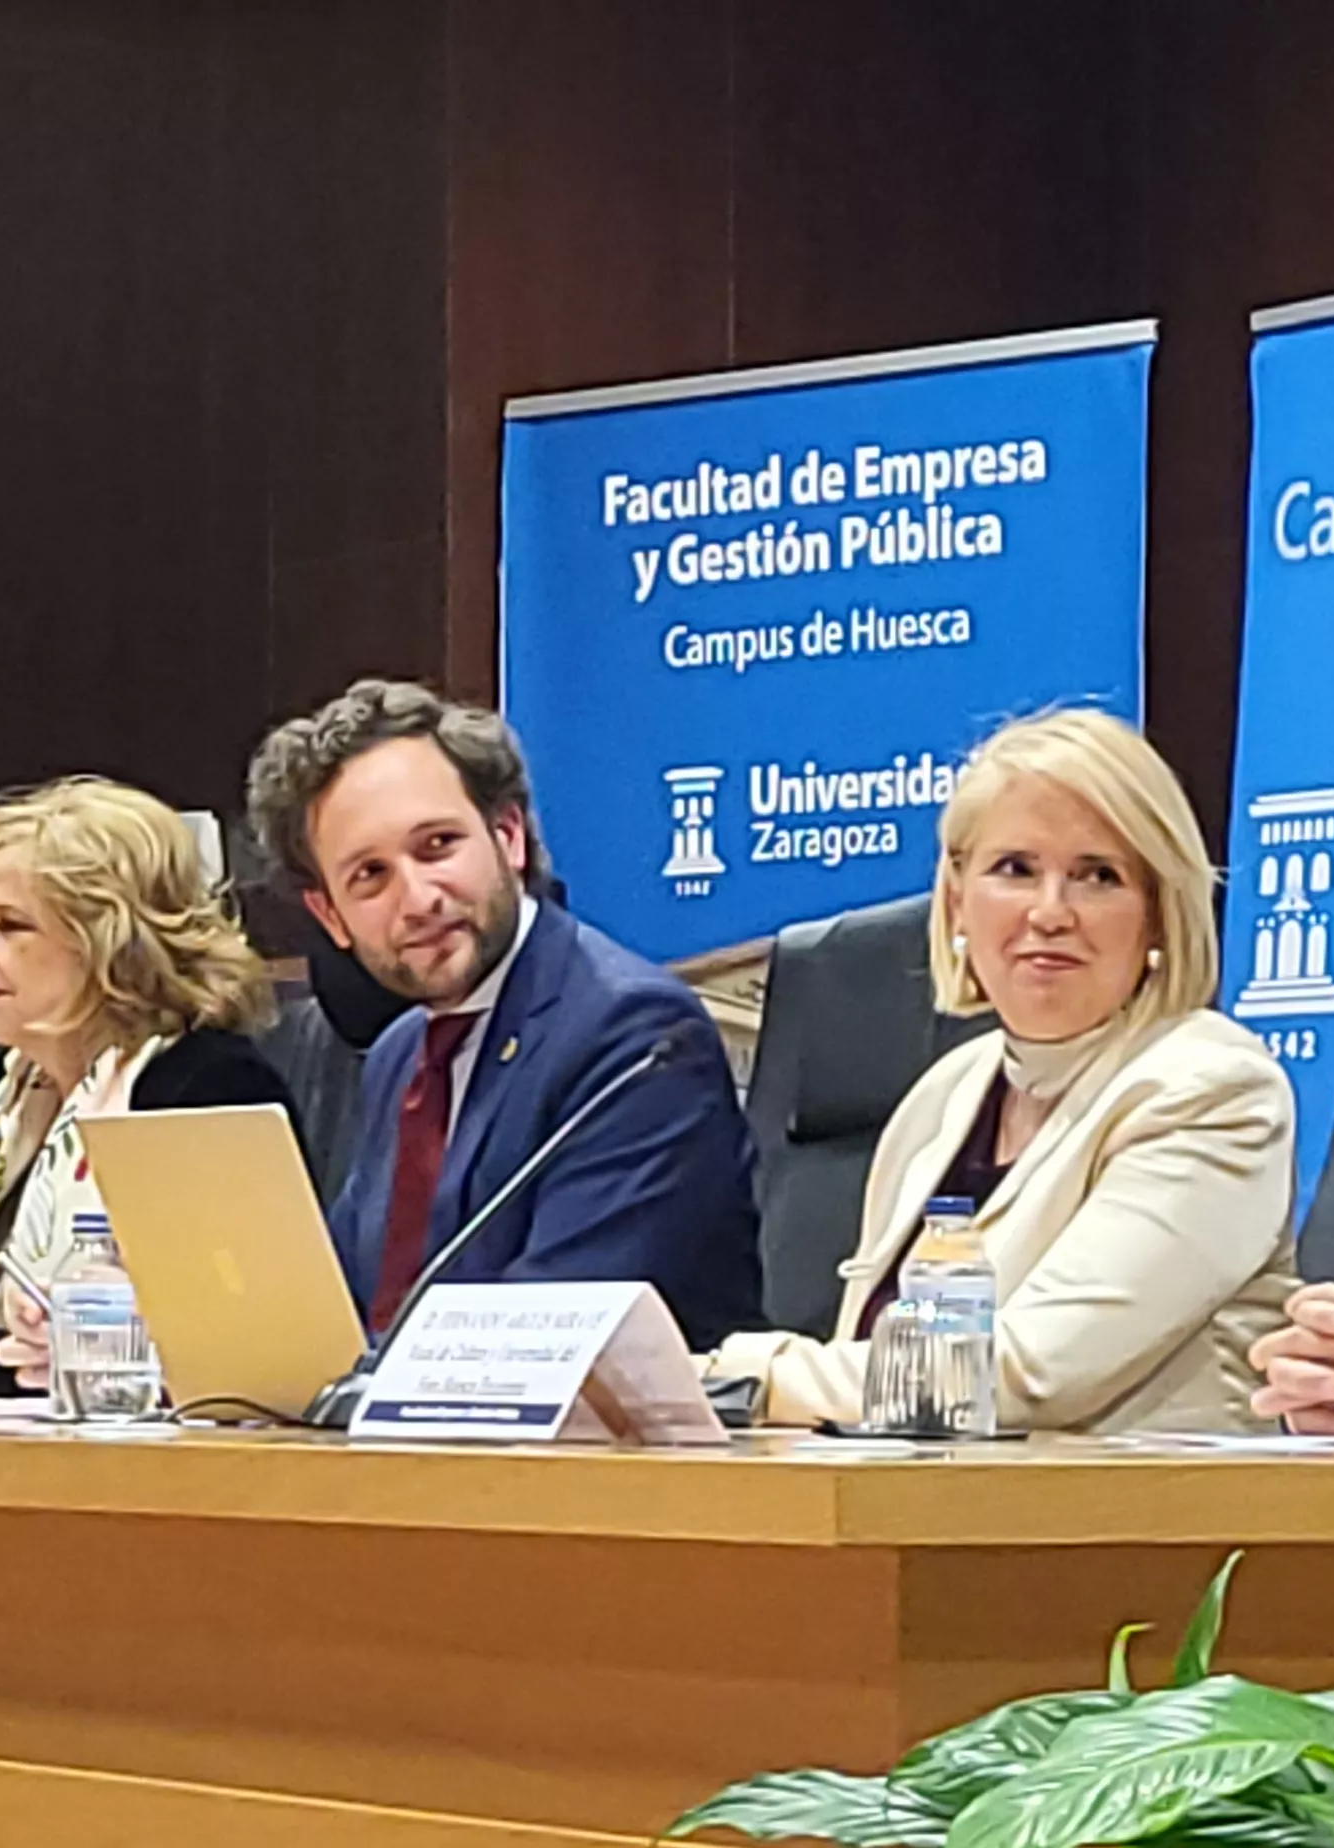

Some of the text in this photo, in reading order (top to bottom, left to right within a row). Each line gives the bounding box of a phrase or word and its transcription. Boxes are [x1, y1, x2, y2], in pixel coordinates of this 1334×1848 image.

[603, 439, 1047, 527] Facultad de Empresa
[632, 504, 1003, 603] y Gestión Pública
[664, 608, 971, 673] Campus de Huesca
[750, 821, 898, 867] Zaragoza
